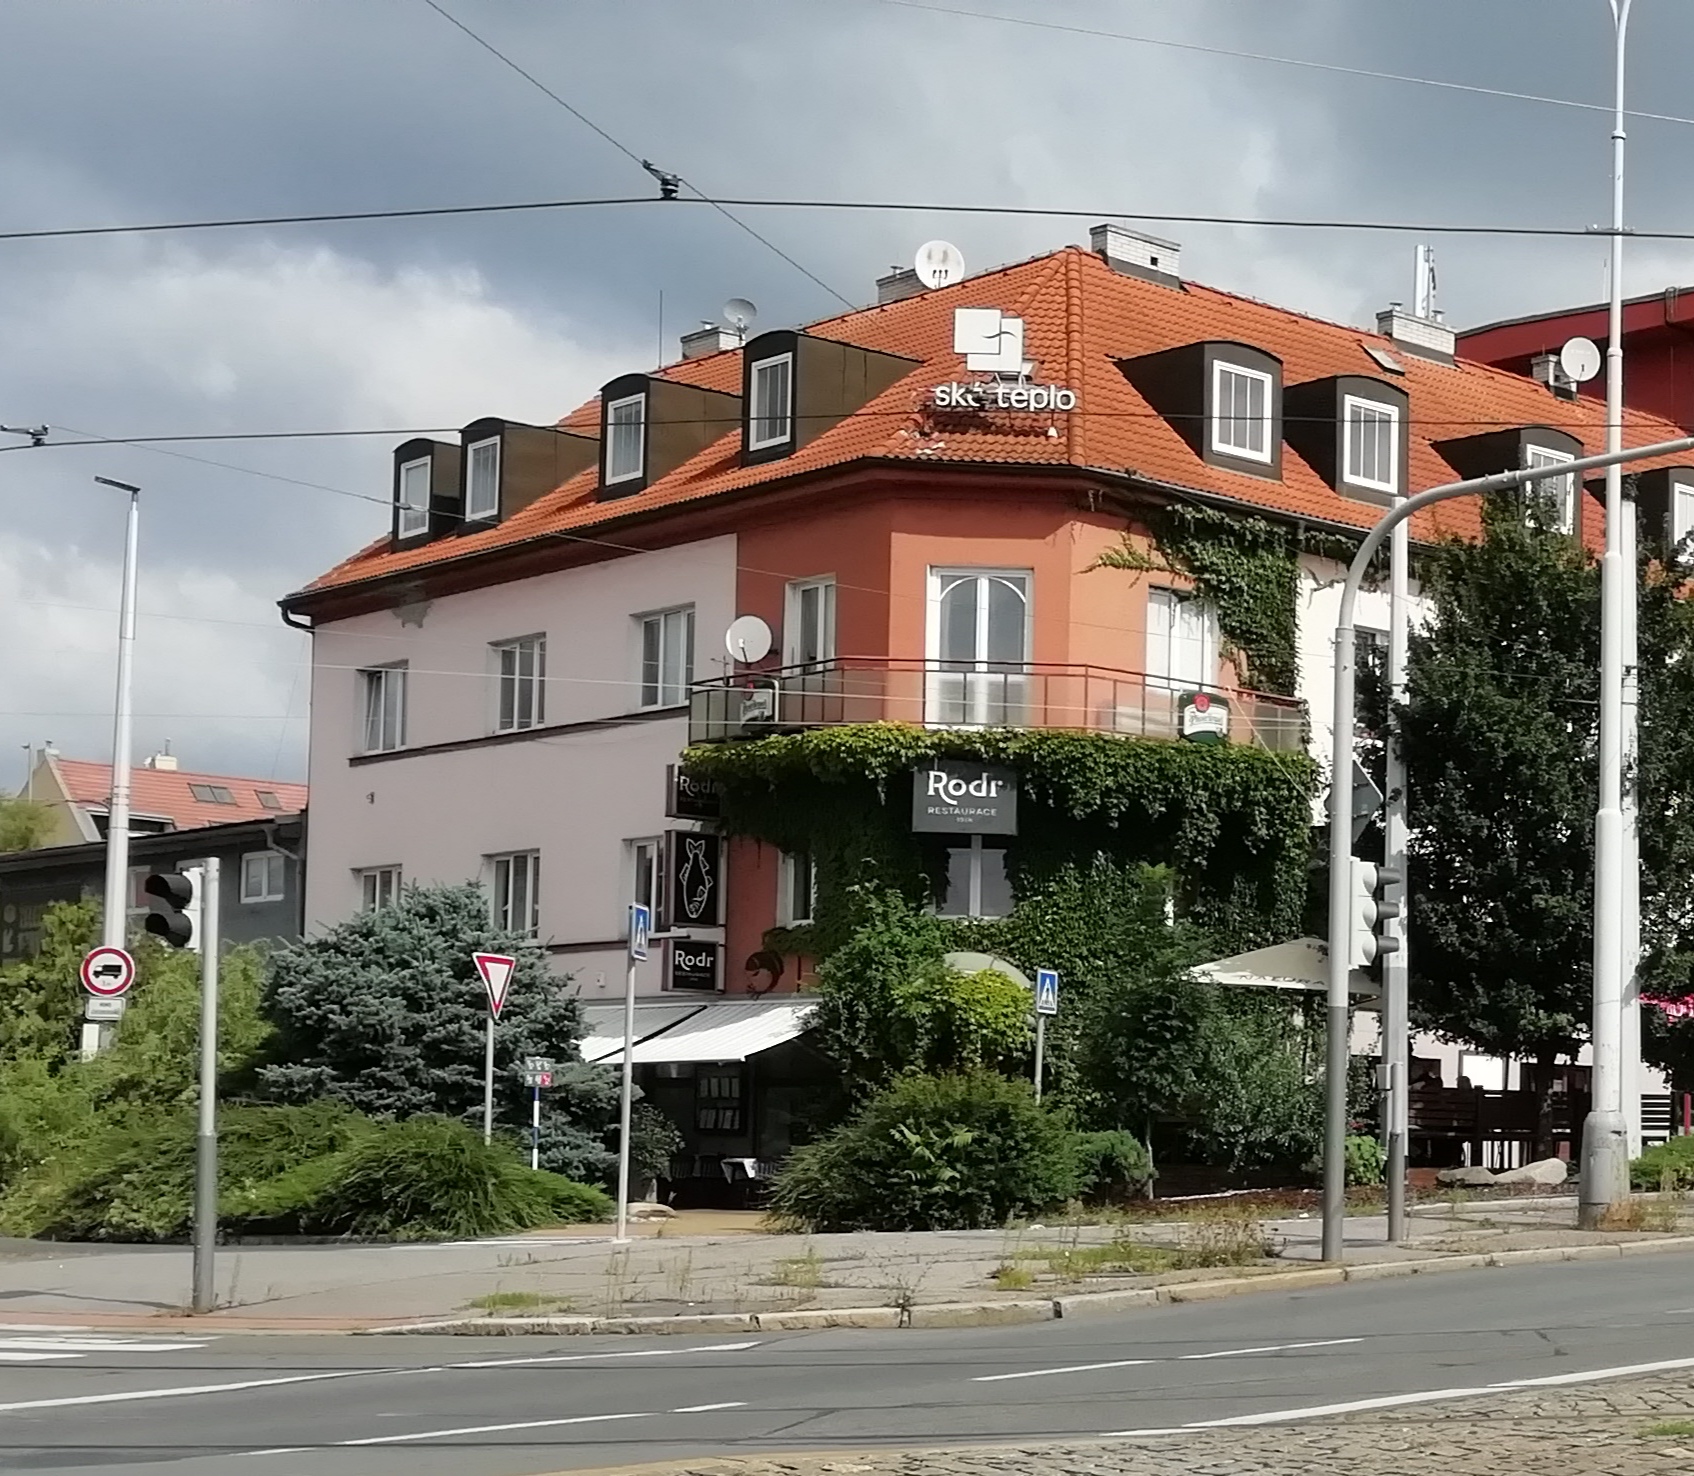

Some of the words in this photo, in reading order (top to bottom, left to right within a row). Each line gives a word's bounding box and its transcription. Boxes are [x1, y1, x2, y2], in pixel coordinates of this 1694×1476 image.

[995, 384, 1076, 411] teplo
[927, 771, 1004, 805] Rodr
[927, 806, 997, 816] RESTAURACE
[675, 950, 714, 971] Rodr
